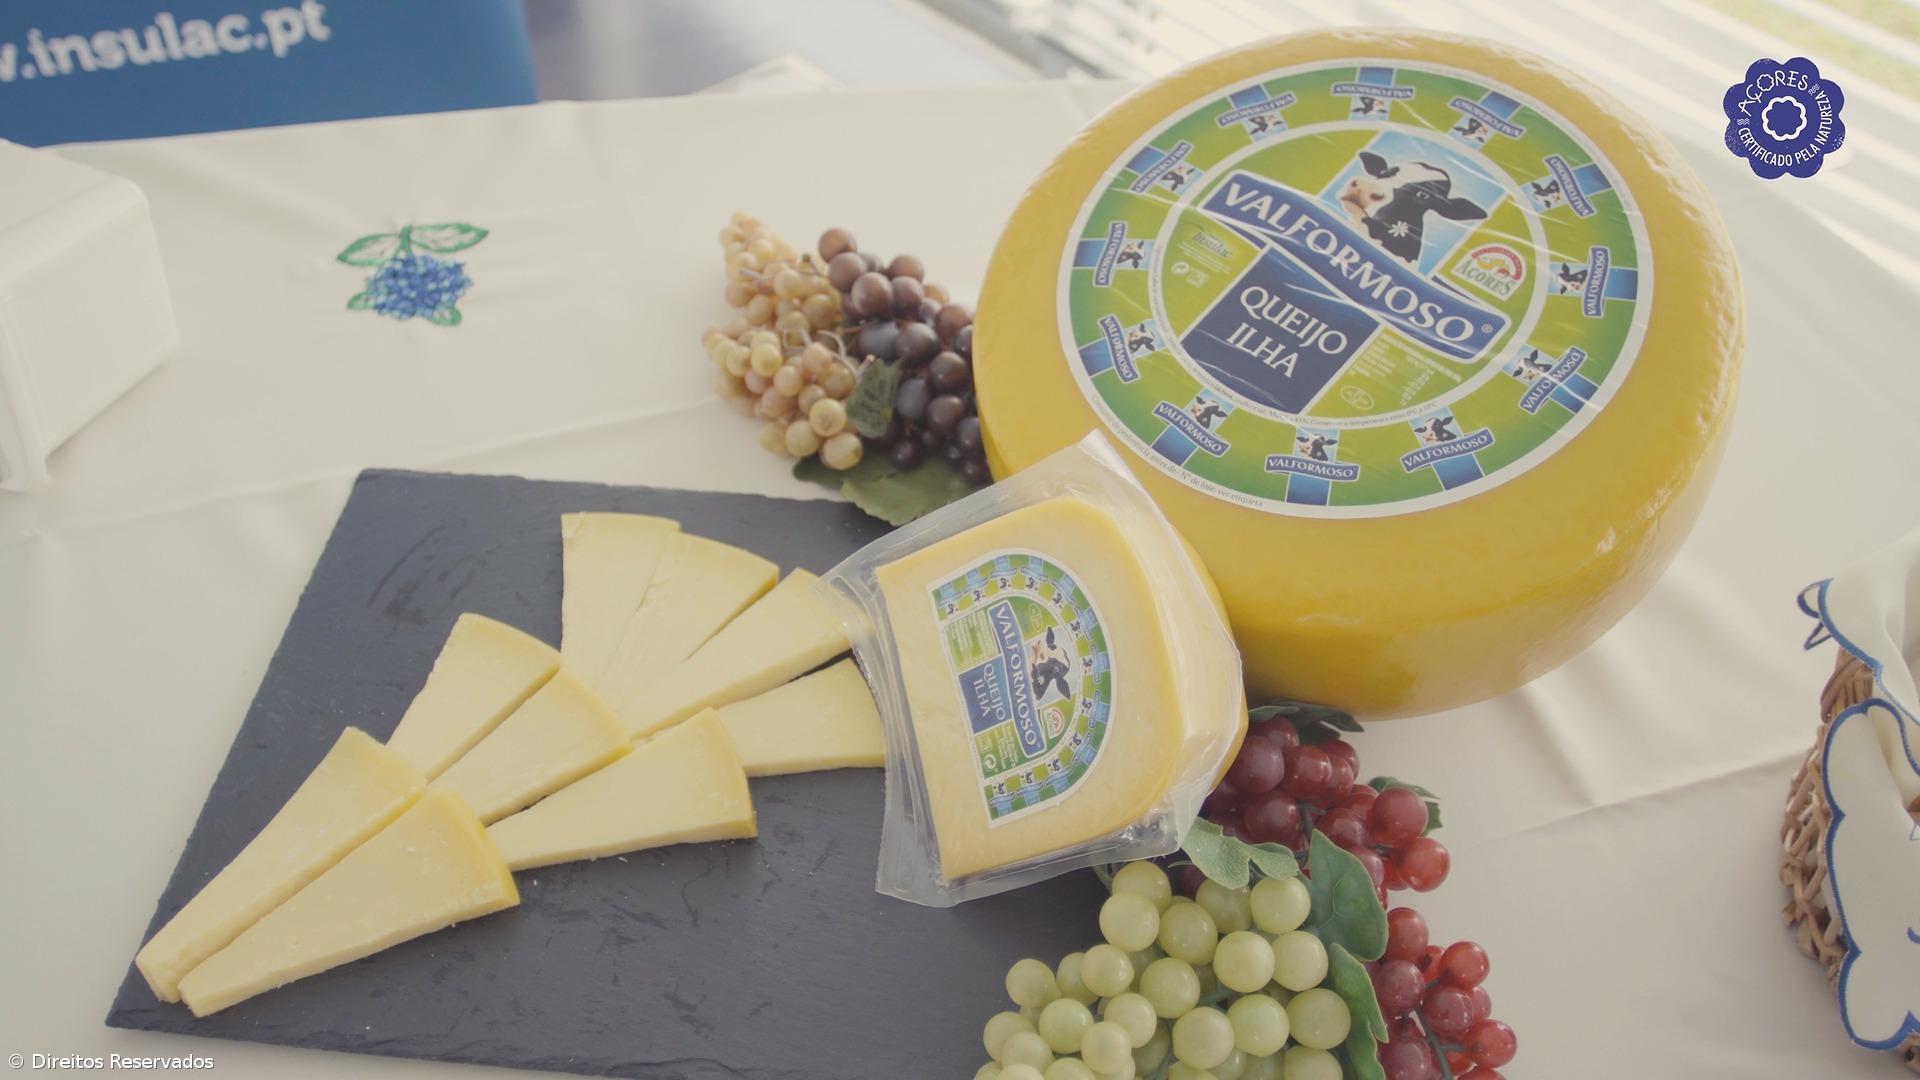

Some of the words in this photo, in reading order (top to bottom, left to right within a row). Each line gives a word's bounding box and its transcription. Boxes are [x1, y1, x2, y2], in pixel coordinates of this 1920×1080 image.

[1587, 250, 1606, 315] VALFORMOSO
[1104, 317, 1133, 379] VALFORMOSO
[1239, 286, 1348, 355] QUEIJO
[1226, 322, 1299, 378] ILHA
[1523, 352, 1580, 409] VALFOMOSO
[1157, 404, 1223, 452] VALFORMOSO
[1404, 434, 1488, 467] VALFORMOSO
[1267, 456, 1354, 478] VALFORMOSO
[972, 679, 989, 717] ILHA
[983, 663, 1006, 721] QUEIJO
[996, 606, 1037, 745] VALFORMOSO
